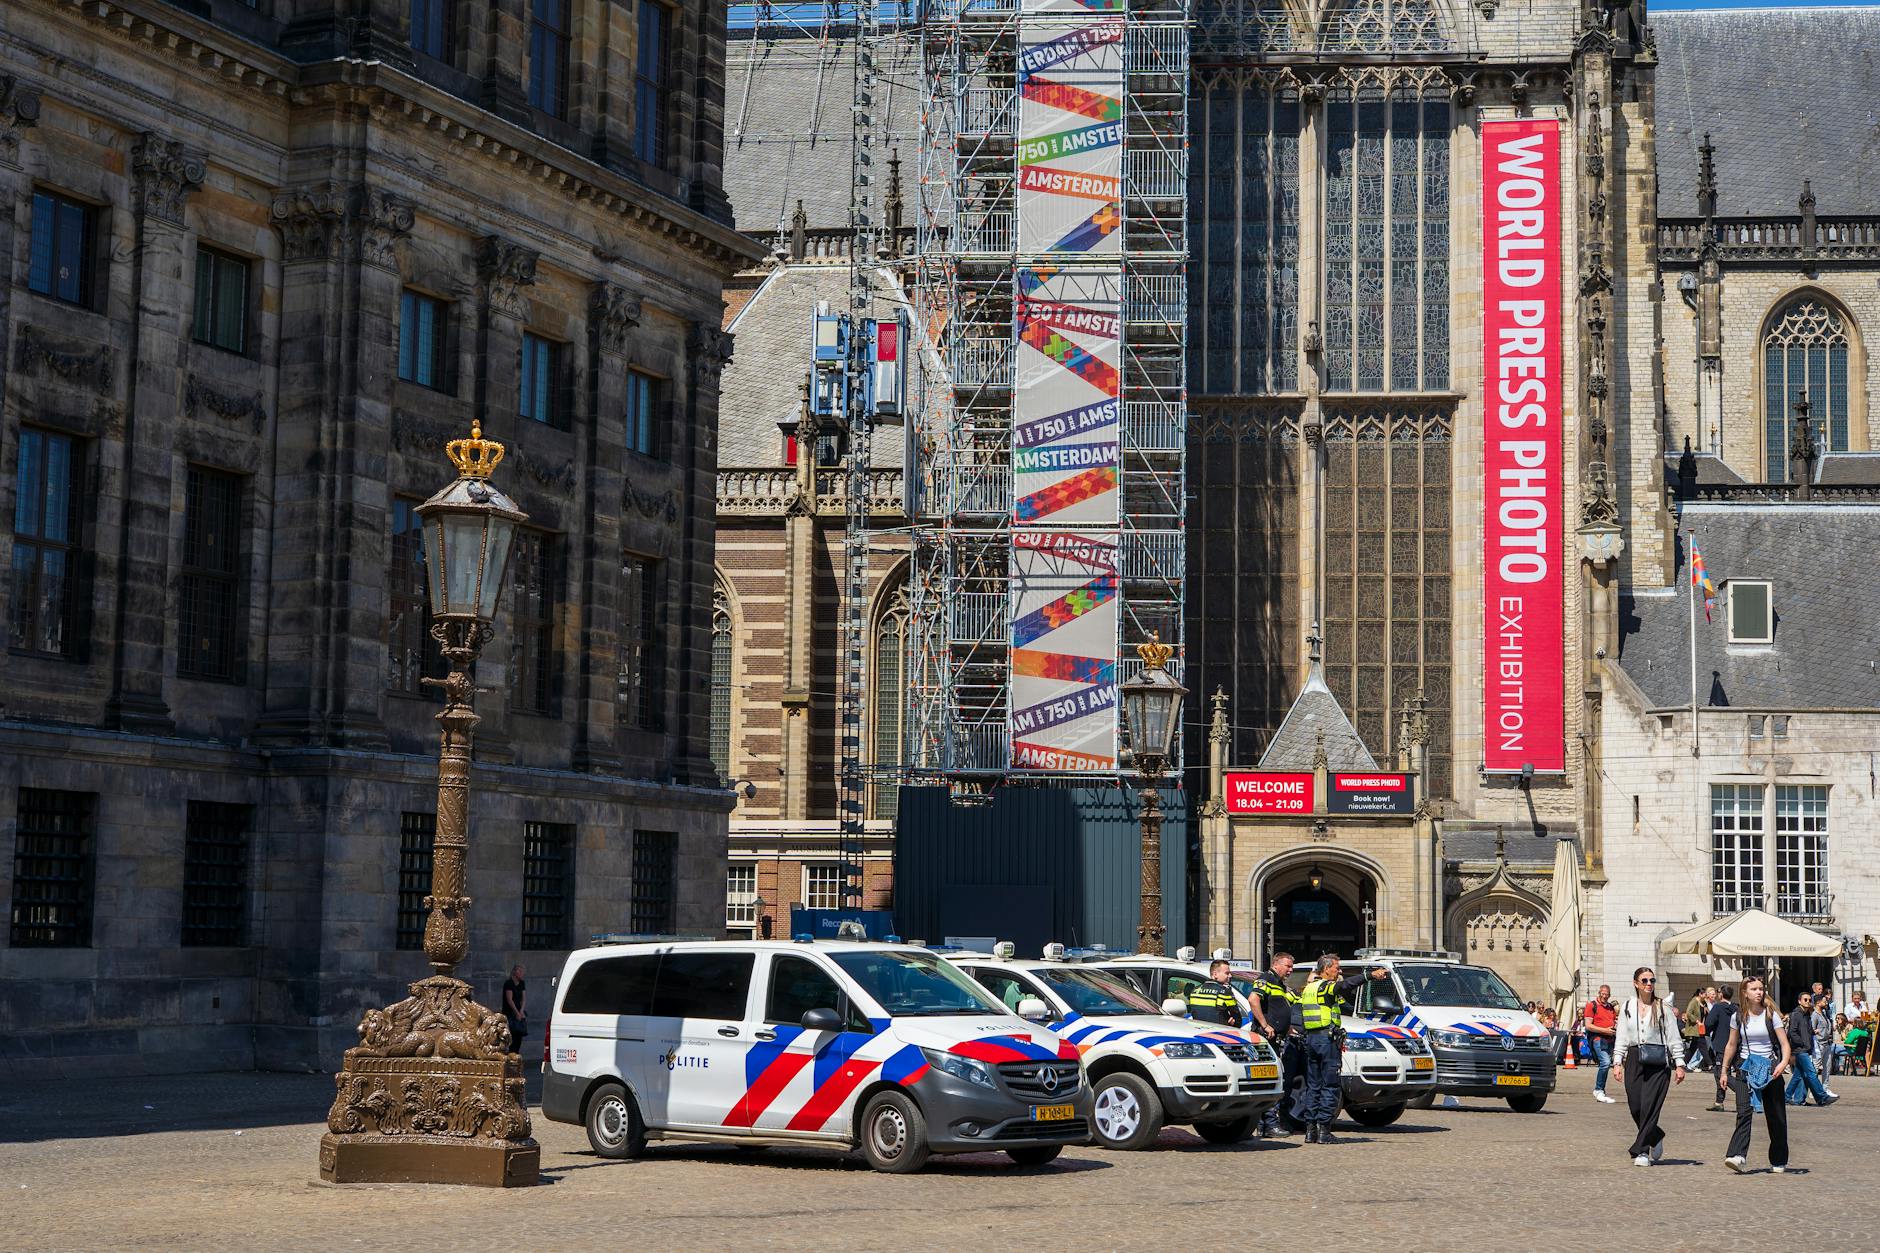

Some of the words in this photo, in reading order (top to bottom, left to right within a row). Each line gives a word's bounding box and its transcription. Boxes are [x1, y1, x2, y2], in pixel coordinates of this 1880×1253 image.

[1019, 141, 1048, 161] 750
[1497, 132, 1545, 288] WORLD
[1498, 301, 1547, 430] PRESS
[1034, 418, 1066, 440] 750
[1015, 446, 1118, 469] AMSTERDAM
[1499, 441, 1548, 583] PHOTO
[1498, 595, 1524, 753] EXHIBITION
[1044, 699, 1077, 723] 750
[1235, 781, 1305, 794] WELCOME
[1340, 778, 1362, 787] WORLD
[1362, 779, 1381, 788] PRESS
[1381, 779, 1401, 788] PHOTO
[1235, 799, 1264, 808] 18.04
[1275, 800, 1304, 809] 21.09
[1348, 803, 1396, 811] nieuwekerk.nl
[1373, 795, 1391, 803] now!
[566, 1049, 577, 1058] 112
[659, 1054, 710, 1071] POLITIE
